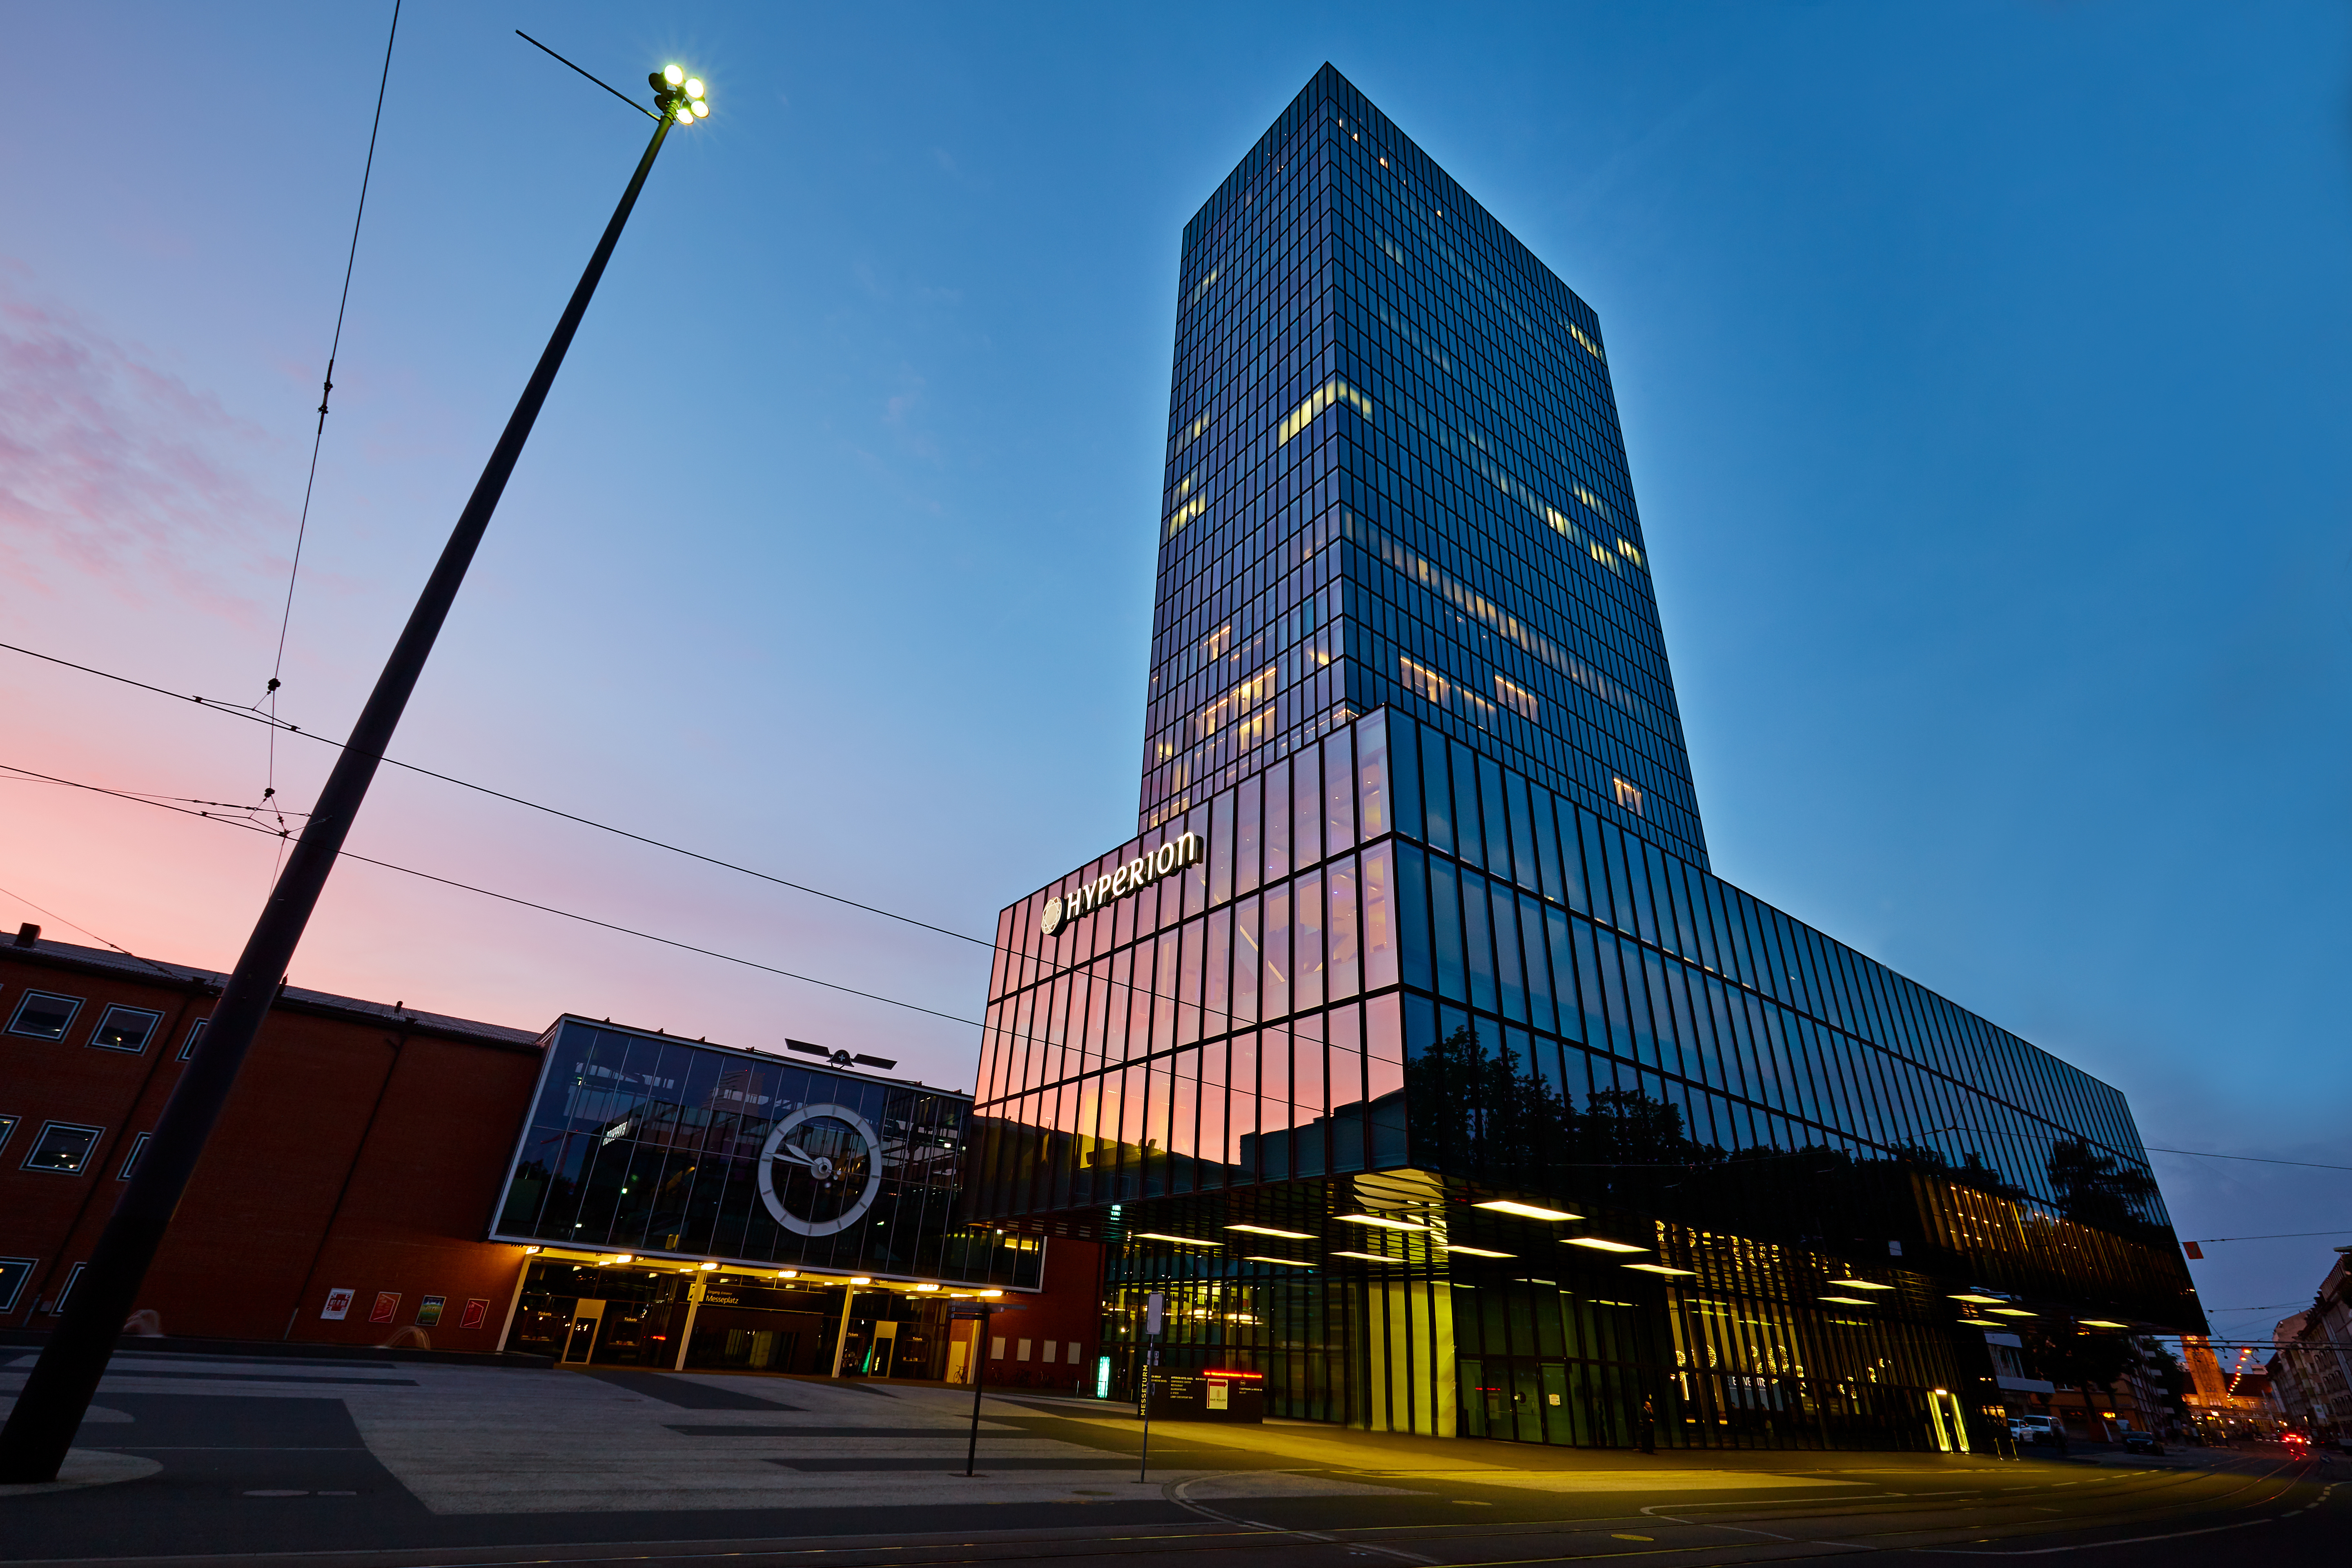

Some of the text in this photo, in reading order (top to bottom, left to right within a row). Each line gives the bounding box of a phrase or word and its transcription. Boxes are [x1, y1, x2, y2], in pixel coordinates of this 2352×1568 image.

[1066, 831, 1196, 920] HYPERION
[706, 1295, 739, 1305] Messeplatz
[1140, 1365, 1148, 1416] MESSETURM
